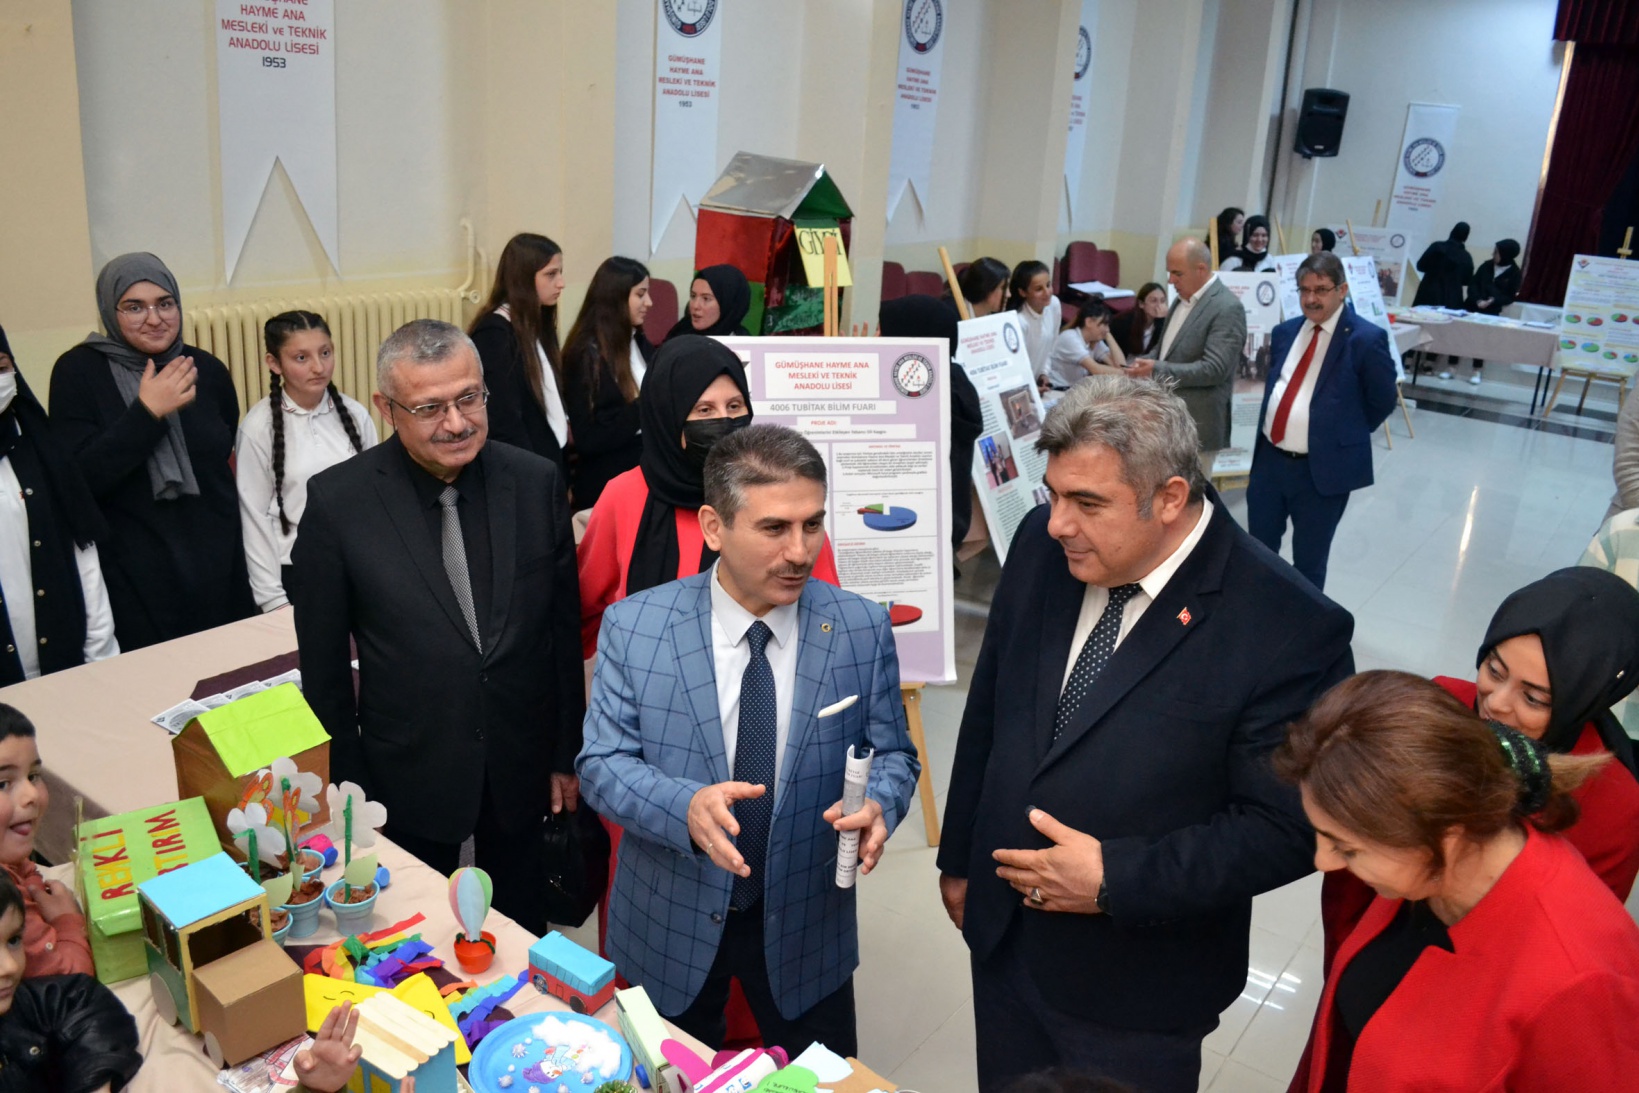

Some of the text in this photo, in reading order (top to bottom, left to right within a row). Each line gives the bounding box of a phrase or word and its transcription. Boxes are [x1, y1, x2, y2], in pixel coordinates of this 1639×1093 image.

[240, 4, 306, 21] HAYME ANA
[221, 19, 268, 34] MESLEKİ
[288, 25, 327, 40] TEKNİK
[228, 37, 319, 55] ANADOLU LİSESİ
[262, 56, 286, 68] 1953
[775, 360, 870, 369] GÜMÜŞHANE HAYME ANA
[788, 371, 819, 379] MESLEKİ
[832, 370, 858, 379] TEKNİK
[794, 381, 853, 390] ANADOLU LİSESİ
[828, 401, 850, 411] BİLİM
[852, 403, 876, 411] FUARI
